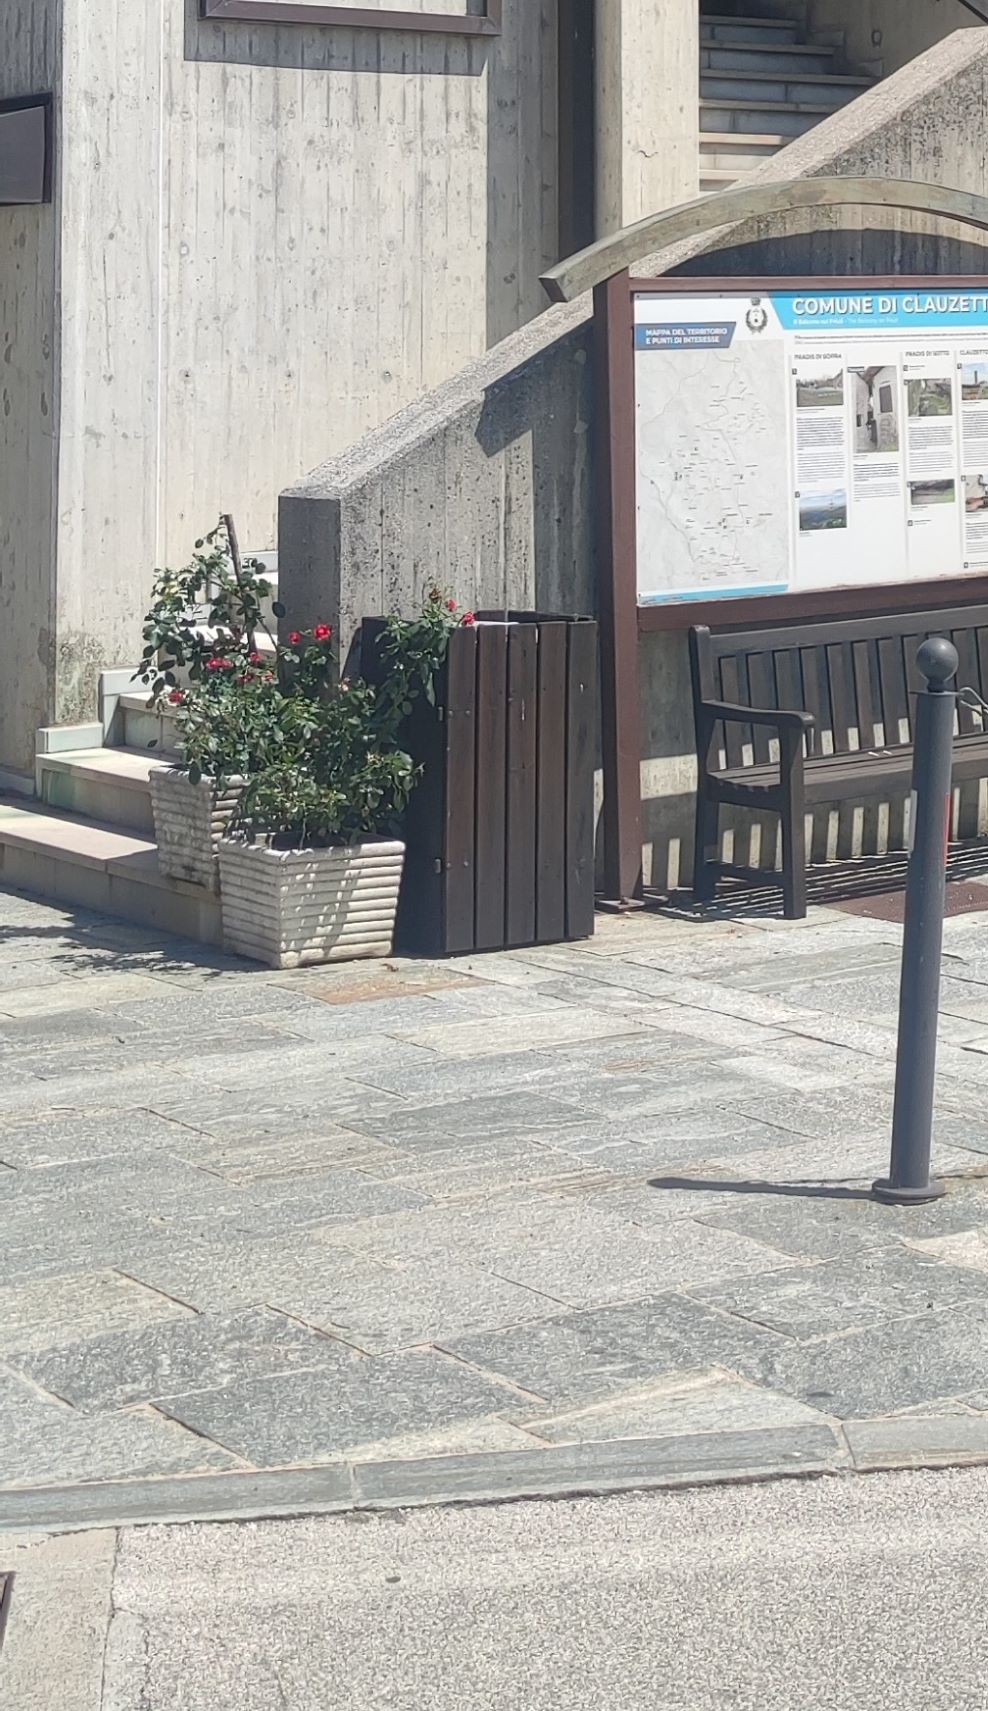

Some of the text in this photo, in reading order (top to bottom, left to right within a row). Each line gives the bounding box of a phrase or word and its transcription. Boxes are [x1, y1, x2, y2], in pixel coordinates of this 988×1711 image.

[793, 297, 874, 315] COMUNE
[879, 297, 898, 314] DI
[672, 328, 686, 336] DEL
